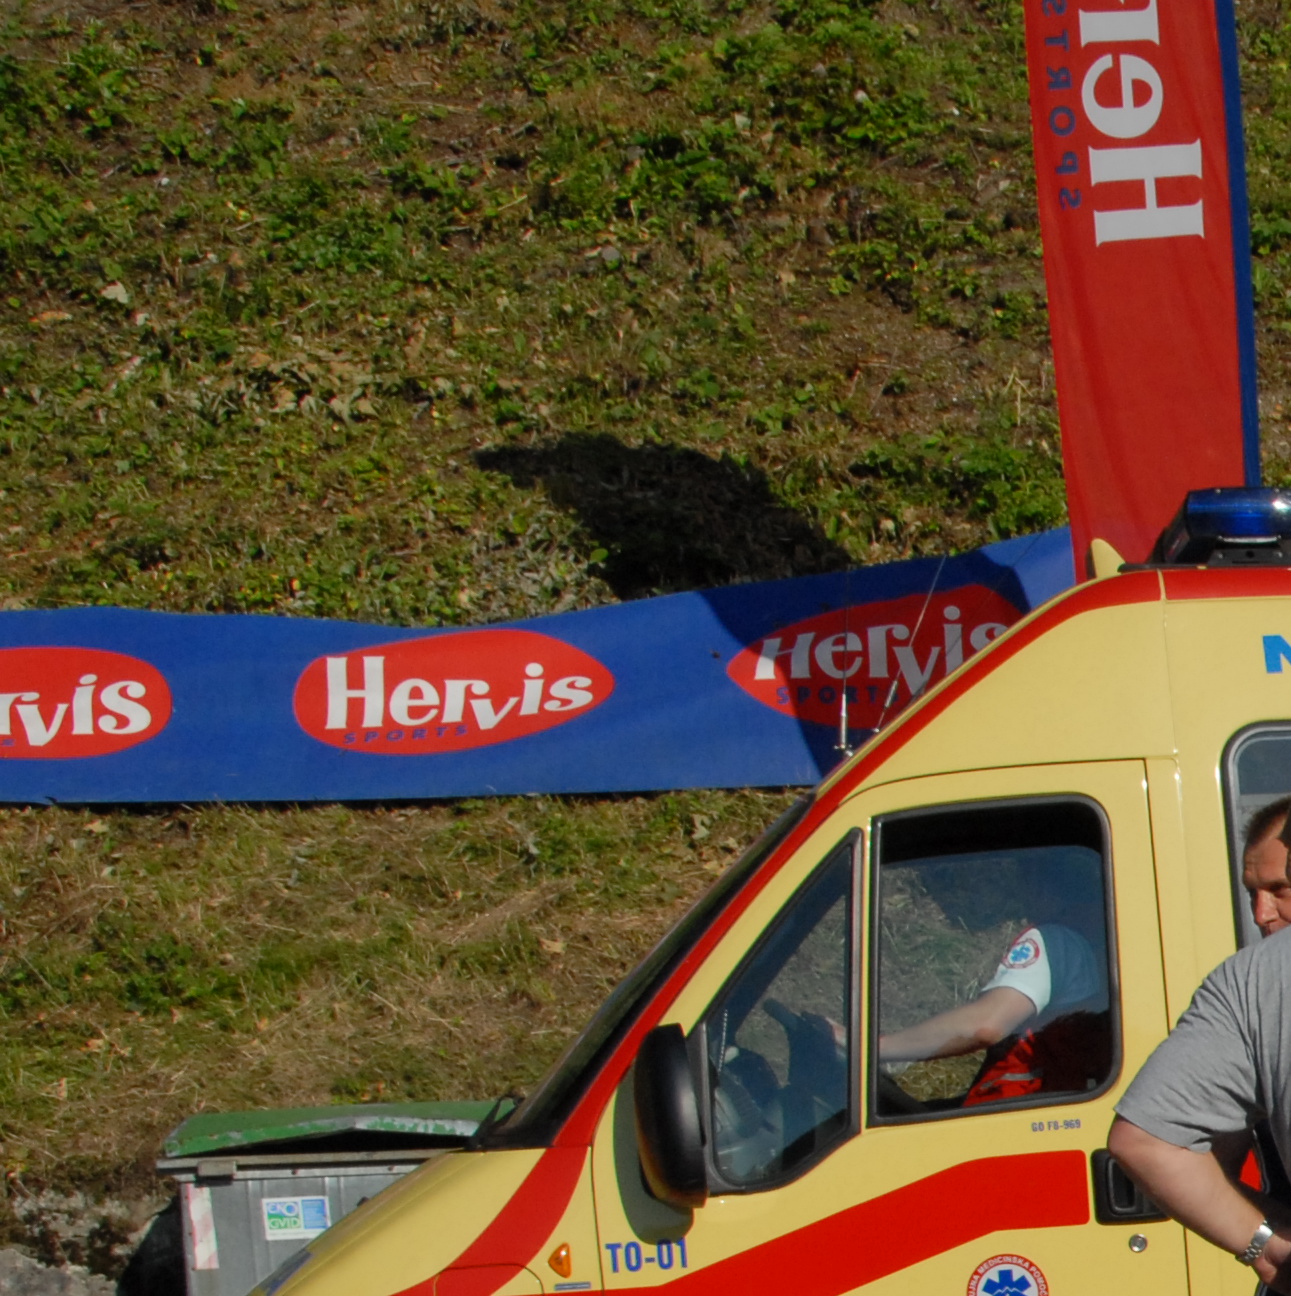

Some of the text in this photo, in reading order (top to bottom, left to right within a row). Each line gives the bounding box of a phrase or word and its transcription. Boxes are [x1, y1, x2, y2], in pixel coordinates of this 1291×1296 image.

[325, 656, 593, 730] Hervis
[344, 725, 468, 744] SPORTS
[606, 1237, 688, 1275] TO-01
[976, 1255, 1030, 1274] MEDICINSKA
